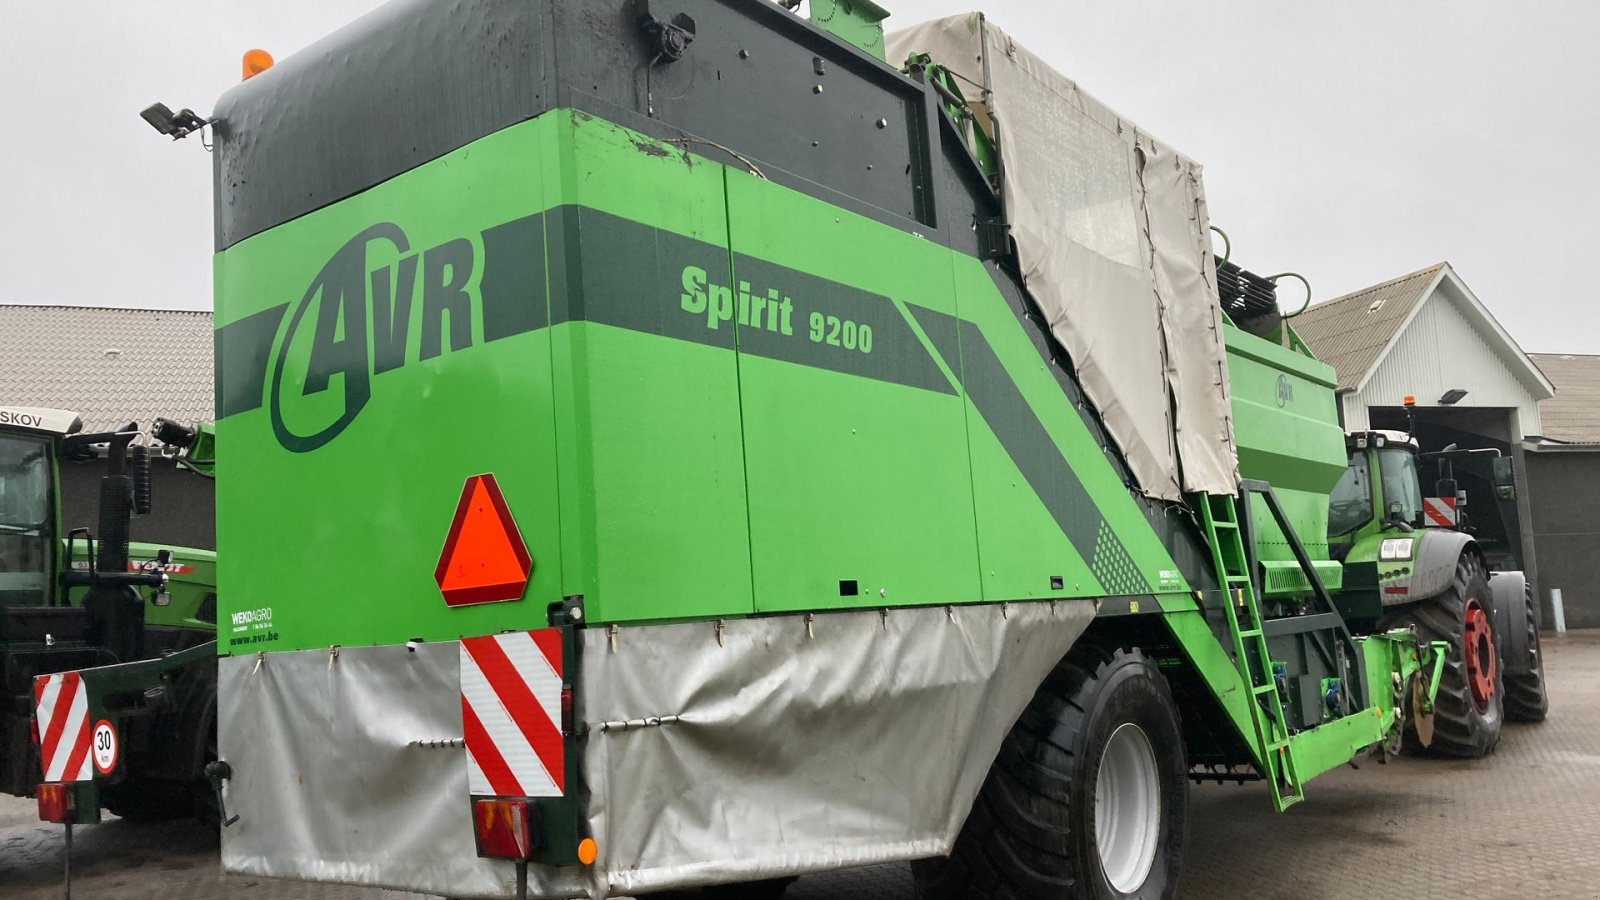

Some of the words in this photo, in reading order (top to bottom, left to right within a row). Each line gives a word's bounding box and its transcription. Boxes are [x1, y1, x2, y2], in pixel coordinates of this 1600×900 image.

[680, 265, 793, 336] Spirit
[809, 311, 873, 354] 9200
[270, 221, 475, 454] AVR
[0, 411, 42, 427] SKOV
[230, 630, 279, 646] www.avr.be
[97, 730, 111, 751] 30
